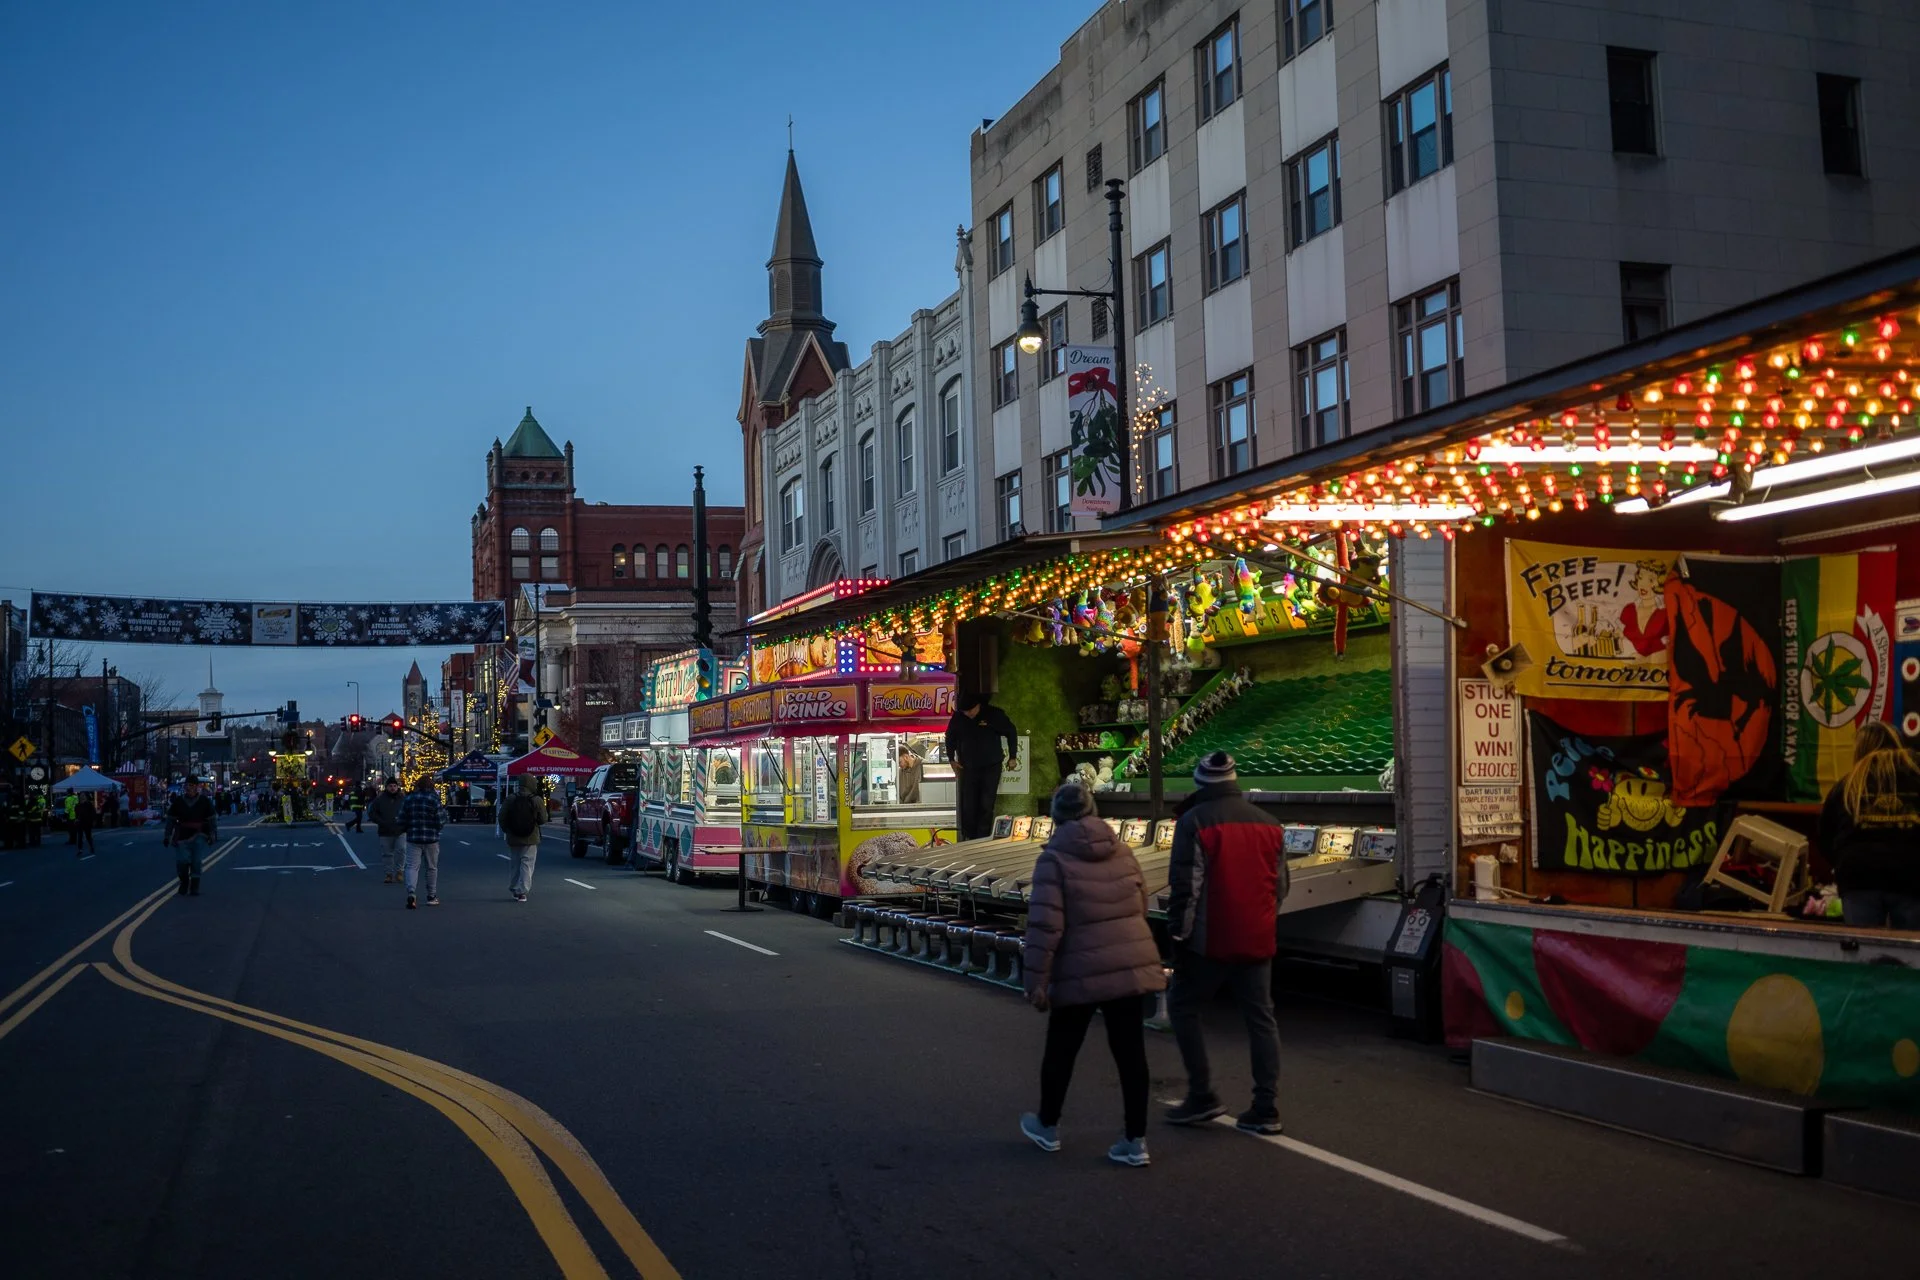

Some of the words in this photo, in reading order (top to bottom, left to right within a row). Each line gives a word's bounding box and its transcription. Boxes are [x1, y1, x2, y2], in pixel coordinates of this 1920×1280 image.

[1070, 350, 1111, 364] Dream
[1520, 557, 1598, 598] FREE
[1543, 565, 1626, 617] BEER!
[1226, 616, 1234, 632] 3
[1271, 608, 1280, 624] 6
[1785, 599, 1797, 637] KEEPS
[1211, 619, 1220, 634] 2
[1785, 640, 1798, 665] THE
[656, 669, 684, 699] COTTON
[1464, 684, 1516, 700] STICK
[785, 690, 832, 703] COLD
[873, 695, 901, 711] Fresh
[902, 693, 933, 711] Made
[1786, 668, 1800, 720] DOCTOR
[779, 700, 847, 720] DRINKS
[1474, 703, 1511, 718] ONE
[1487, 722, 1499, 737] U
[1474, 741, 1513, 756] WIN!
[1784, 725, 1799, 765] AWAY
[1467, 762, 1517, 778] CHOICE
